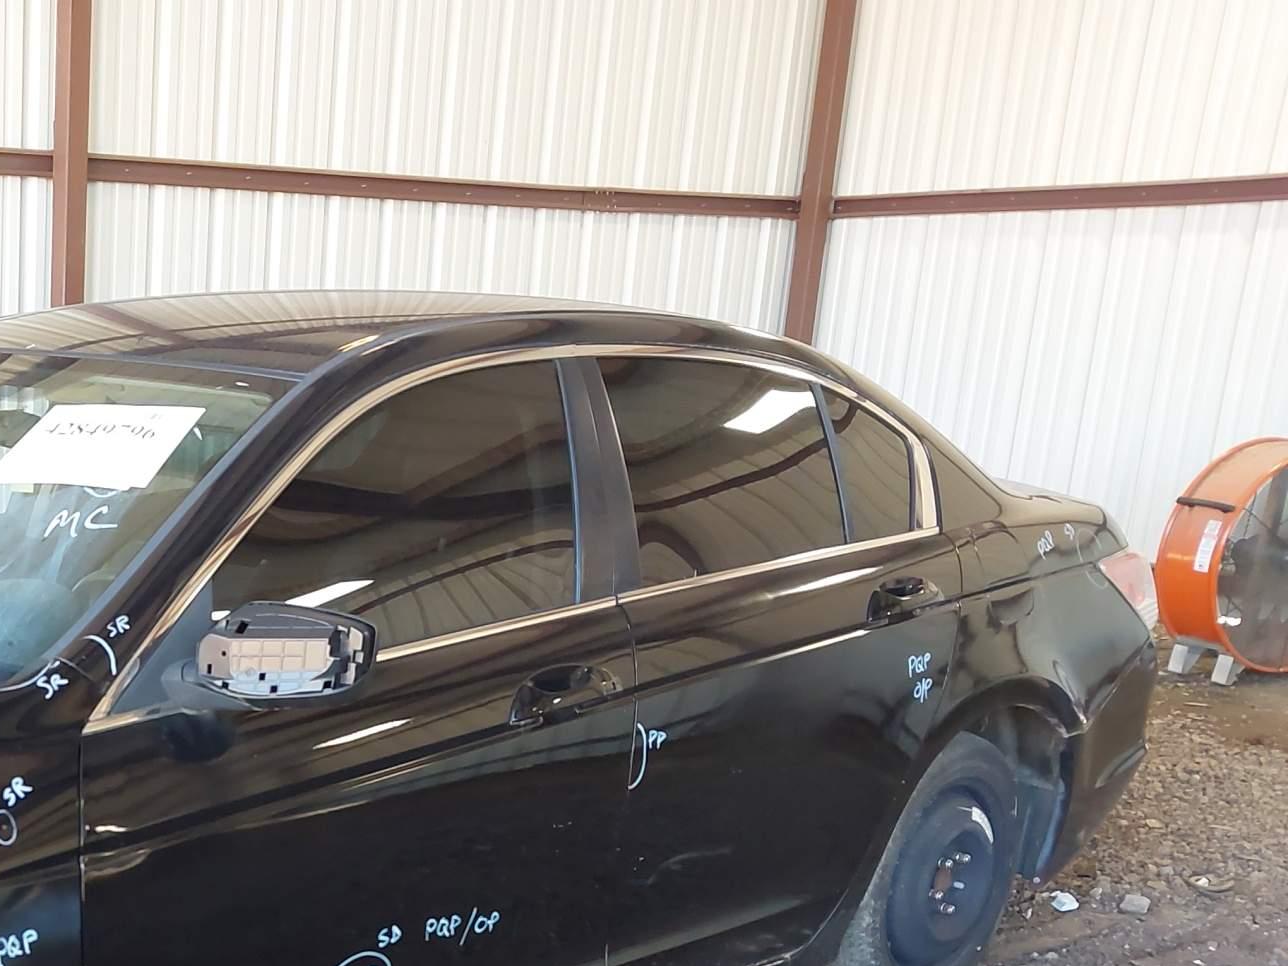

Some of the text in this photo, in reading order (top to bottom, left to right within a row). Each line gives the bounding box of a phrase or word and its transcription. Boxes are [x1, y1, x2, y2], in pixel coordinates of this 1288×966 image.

[42, 504, 119, 538] MC
[106, 614, 131, 638] SR
[908, 652, 931, 678] PQP
[36, 673, 69, 700] SR
[2, 776, 34, 807] SR
[376, 924, 403, 949] SD
